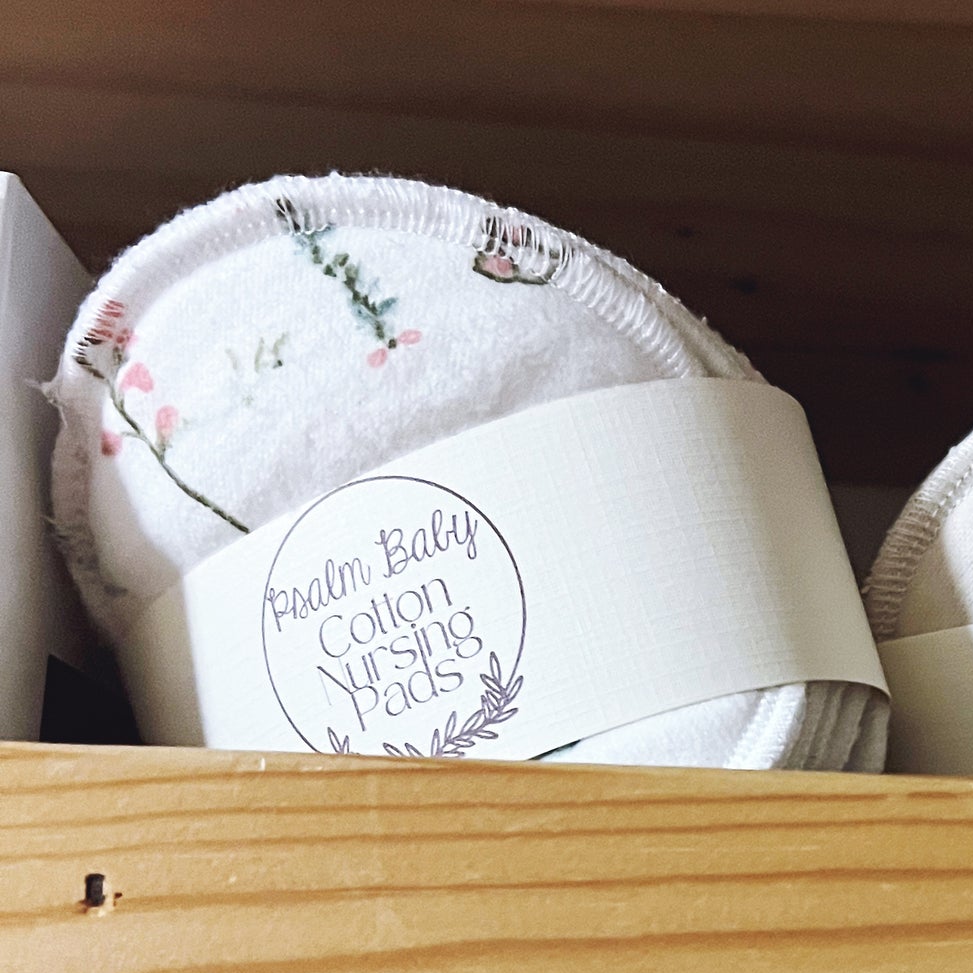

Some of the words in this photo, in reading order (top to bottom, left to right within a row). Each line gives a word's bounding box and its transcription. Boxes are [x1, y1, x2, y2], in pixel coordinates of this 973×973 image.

[374, 509, 478, 578] Baby
[317, 606, 483, 706] Nursing
[319, 578, 453, 658] Cotton
[350, 651, 465, 732] Pads
